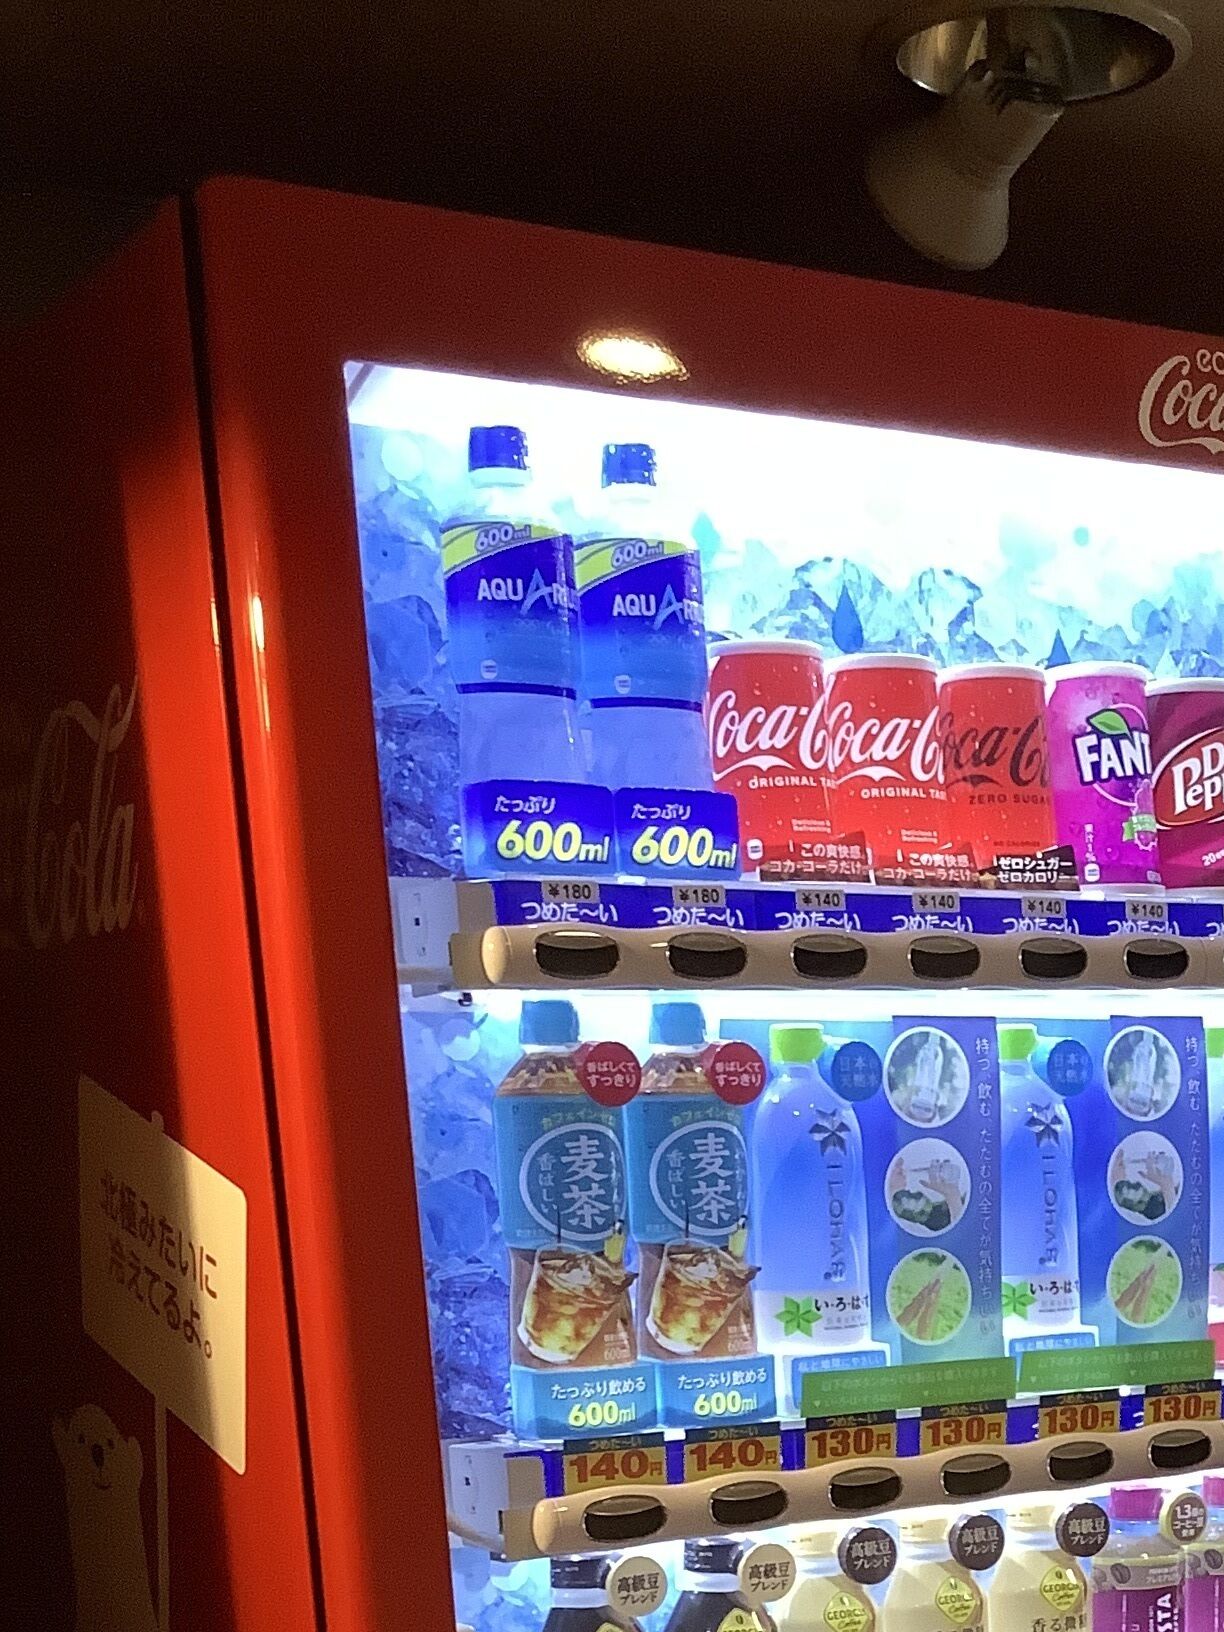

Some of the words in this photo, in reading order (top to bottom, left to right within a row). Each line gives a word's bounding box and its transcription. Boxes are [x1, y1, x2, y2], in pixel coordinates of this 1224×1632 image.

[476, 523, 532, 551] 600ml
[611, 541, 664, 568] 600ml
[749, 775, 817, 789] ORIGINAL
[861, 788, 926, 799] ORIGINAL
[495, 795, 556, 814] たっぷり
[631, 803, 691, 821] たっぷり
[497, 820, 610, 862] 600ml
[632, 826, 737, 869] 600ml
[998, 857, 1073, 871] ゼロシュガー
[998, 870, 1078, 883] ゼロカロリー
[549, 884, 592, 900] ¥180
[679, 888, 720, 904] ¥180
[802, 893, 841, 907] ¥140
[919, 895, 955, 910] ¥140
[1027, 900, 1062, 915] ¥140
[1131, 904, 1164, 918] ¥140
[587, 1062, 635, 1073] 香ばしくて
[715, 1062, 761, 1073] 香ばしくて
[587, 1073, 637, 1087] すっきり
[715, 1073, 761, 1087] すっきり
[561, 1134, 611, 1229] 麦茶
[689, 1132, 736, 1225] 麦茶
[101, 1168, 218, 1300] 北極みたいに
[107, 1236, 213, 1360] 冷えてるよ。
[551, 1376, 646, 1399] たっぷり飲める
[678, 1367, 767, 1389] たっぷり飲める
[694, 1390, 757, 1417] 600ml
[1150, 1395, 1216, 1423] 130円
[568, 1400, 635, 1427] 600ml
[1043, 1404, 1115, 1434] 130円
[926, 1416, 1001, 1447] 130円
[812, 1427, 891, 1459] 130円
[690, 1439, 777, 1472] 140円
[569, 1450, 662, 1483] 140円
[961, 1524, 999, 1543] 高級豆
[1067, 1516, 1106, 1535] 高級豆
[851, 1539, 892, 1557] 高級豆
[964, 1542, 998, 1555] ブレンド
[1070, 1533, 1104, 1545] ブレンド
[748, 1561, 790, 1580] 高級豆
[853, 1556, 890, 1571] ブレンド
[617, 1573, 660, 1593] 高級豆
[750, 1580, 789, 1593] ブレンド
[620, 1593, 659, 1606] ブレンド
